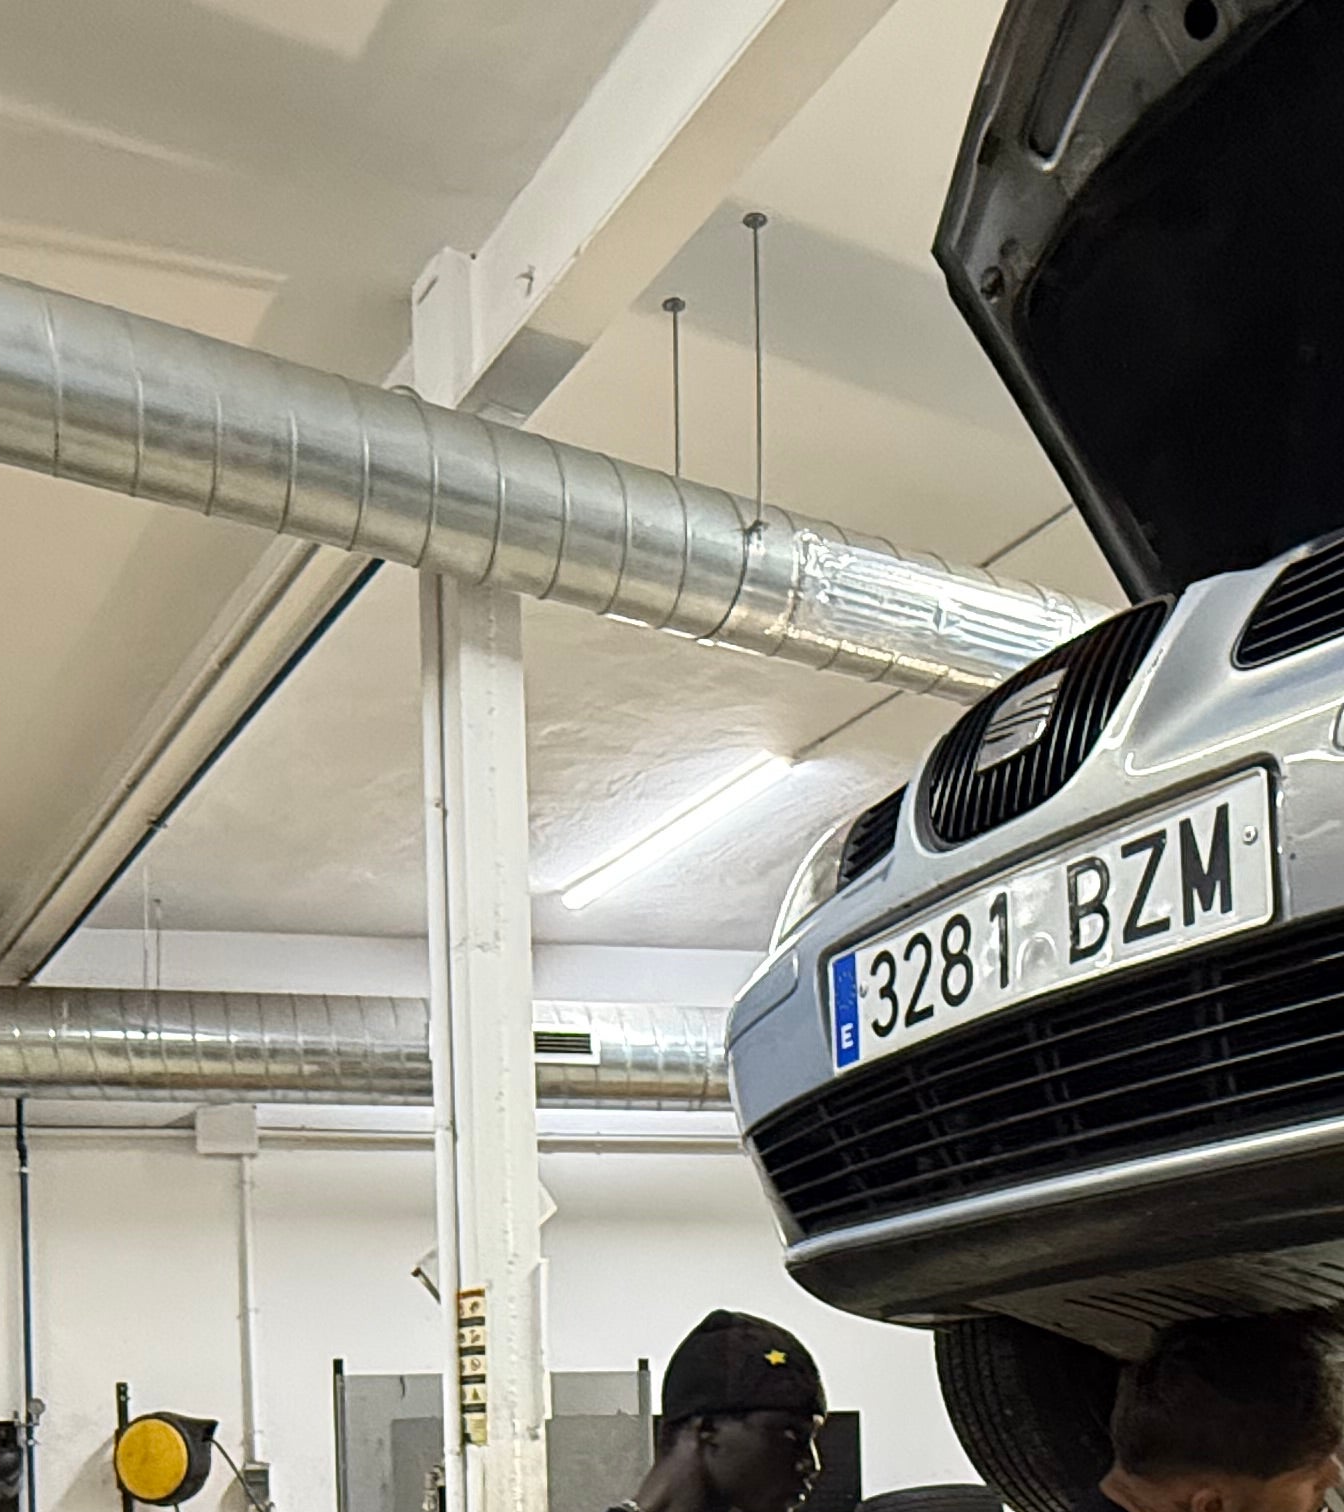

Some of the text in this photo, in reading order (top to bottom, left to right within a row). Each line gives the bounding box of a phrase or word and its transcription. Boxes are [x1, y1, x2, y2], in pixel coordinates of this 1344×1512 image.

[839, 802, 1234, 1049] E 3281 BZM
